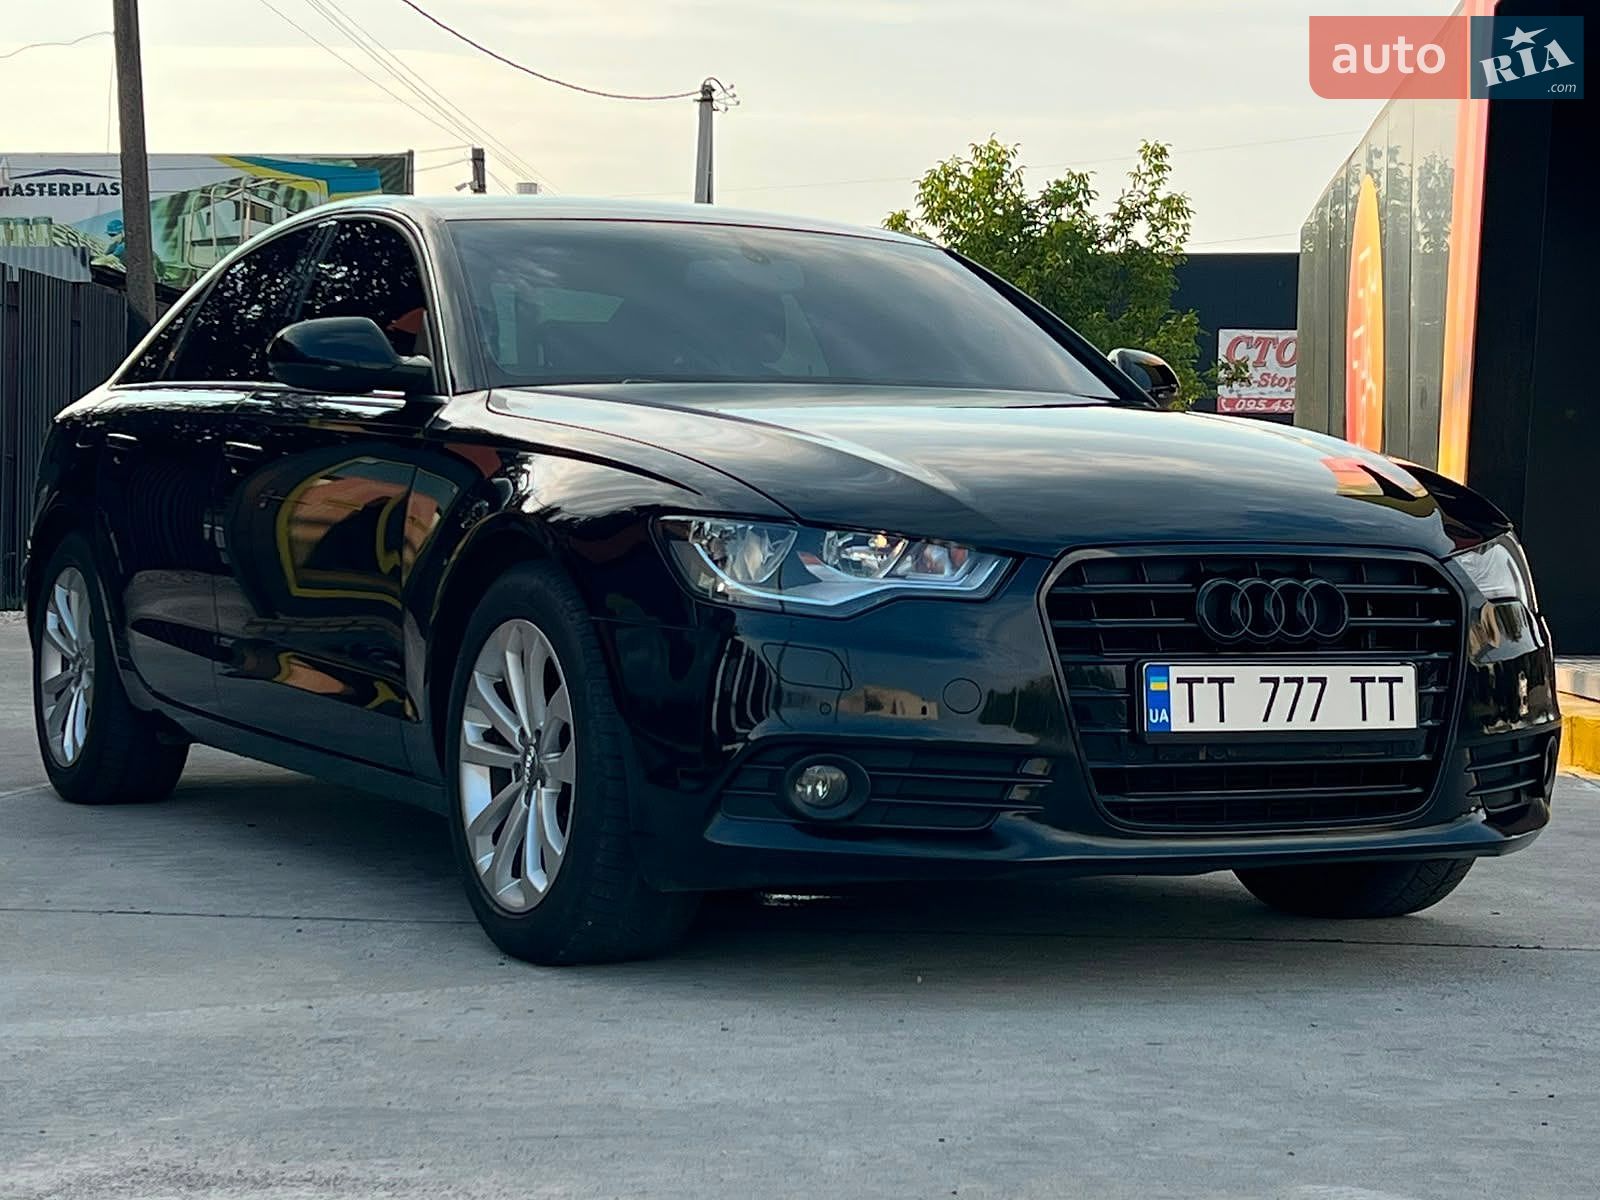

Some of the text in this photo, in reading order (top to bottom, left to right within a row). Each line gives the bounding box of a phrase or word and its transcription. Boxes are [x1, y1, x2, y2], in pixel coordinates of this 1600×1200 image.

[1235, 399, 1296, 411] 095 43
[1176, 676, 1404, 723] TT 777 TT
[1149, 708, 1169, 723] UA
